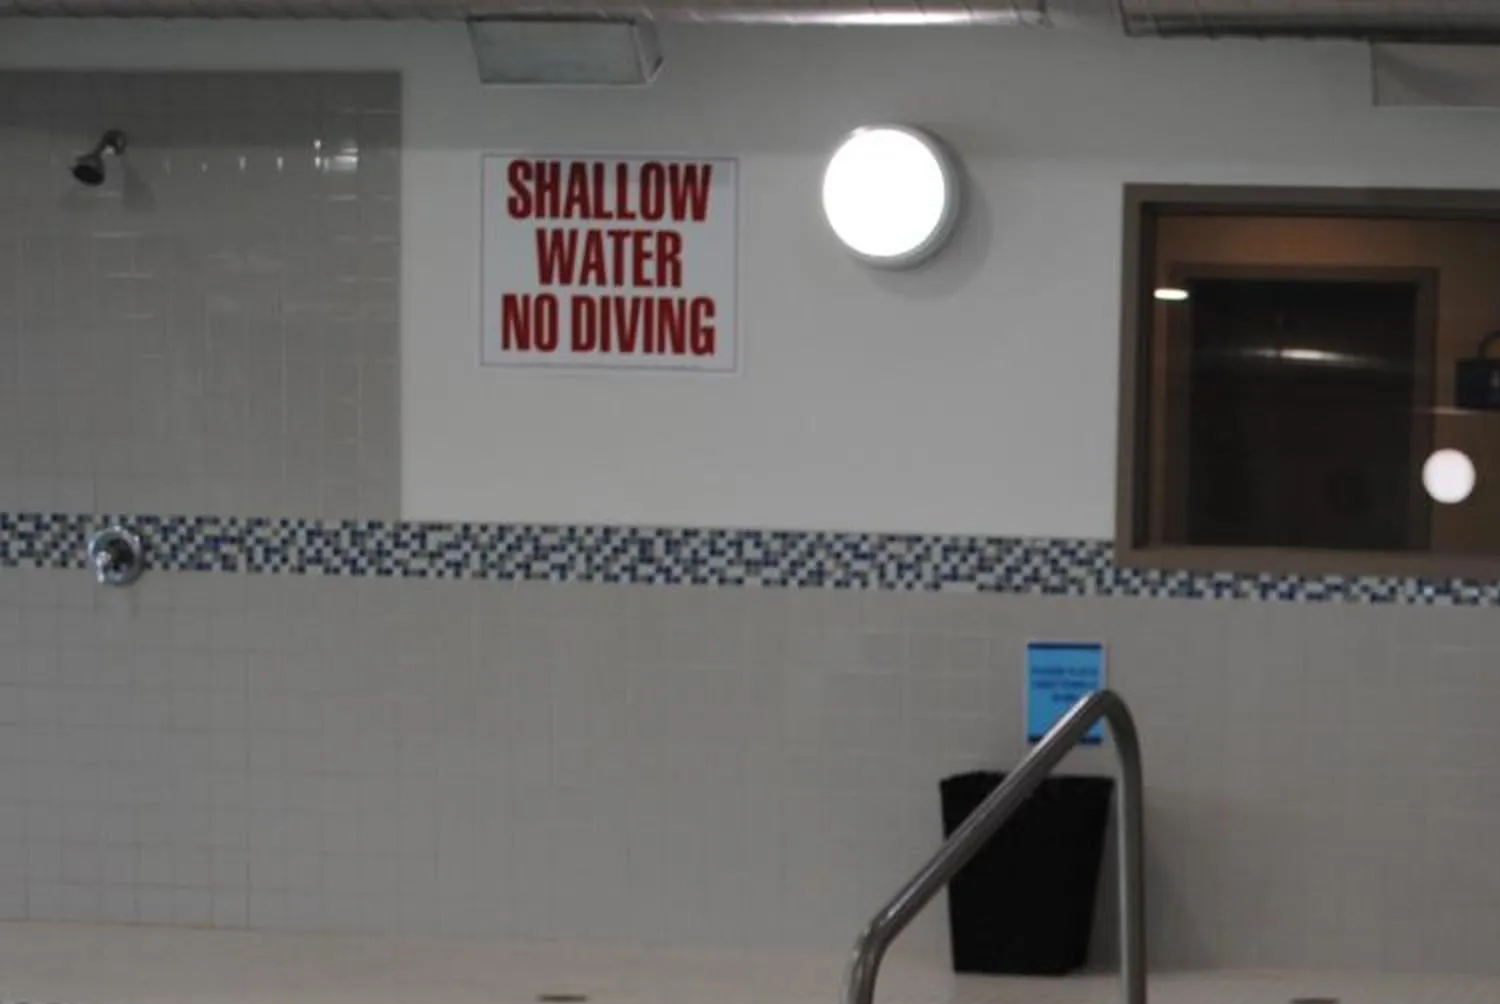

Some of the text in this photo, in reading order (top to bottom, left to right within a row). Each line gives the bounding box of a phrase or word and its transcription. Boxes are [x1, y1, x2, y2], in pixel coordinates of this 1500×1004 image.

[507, 159, 712, 222] SHALLOW
[535, 227, 683, 288] WATER
[501, 293, 716, 356] NO DIVING
